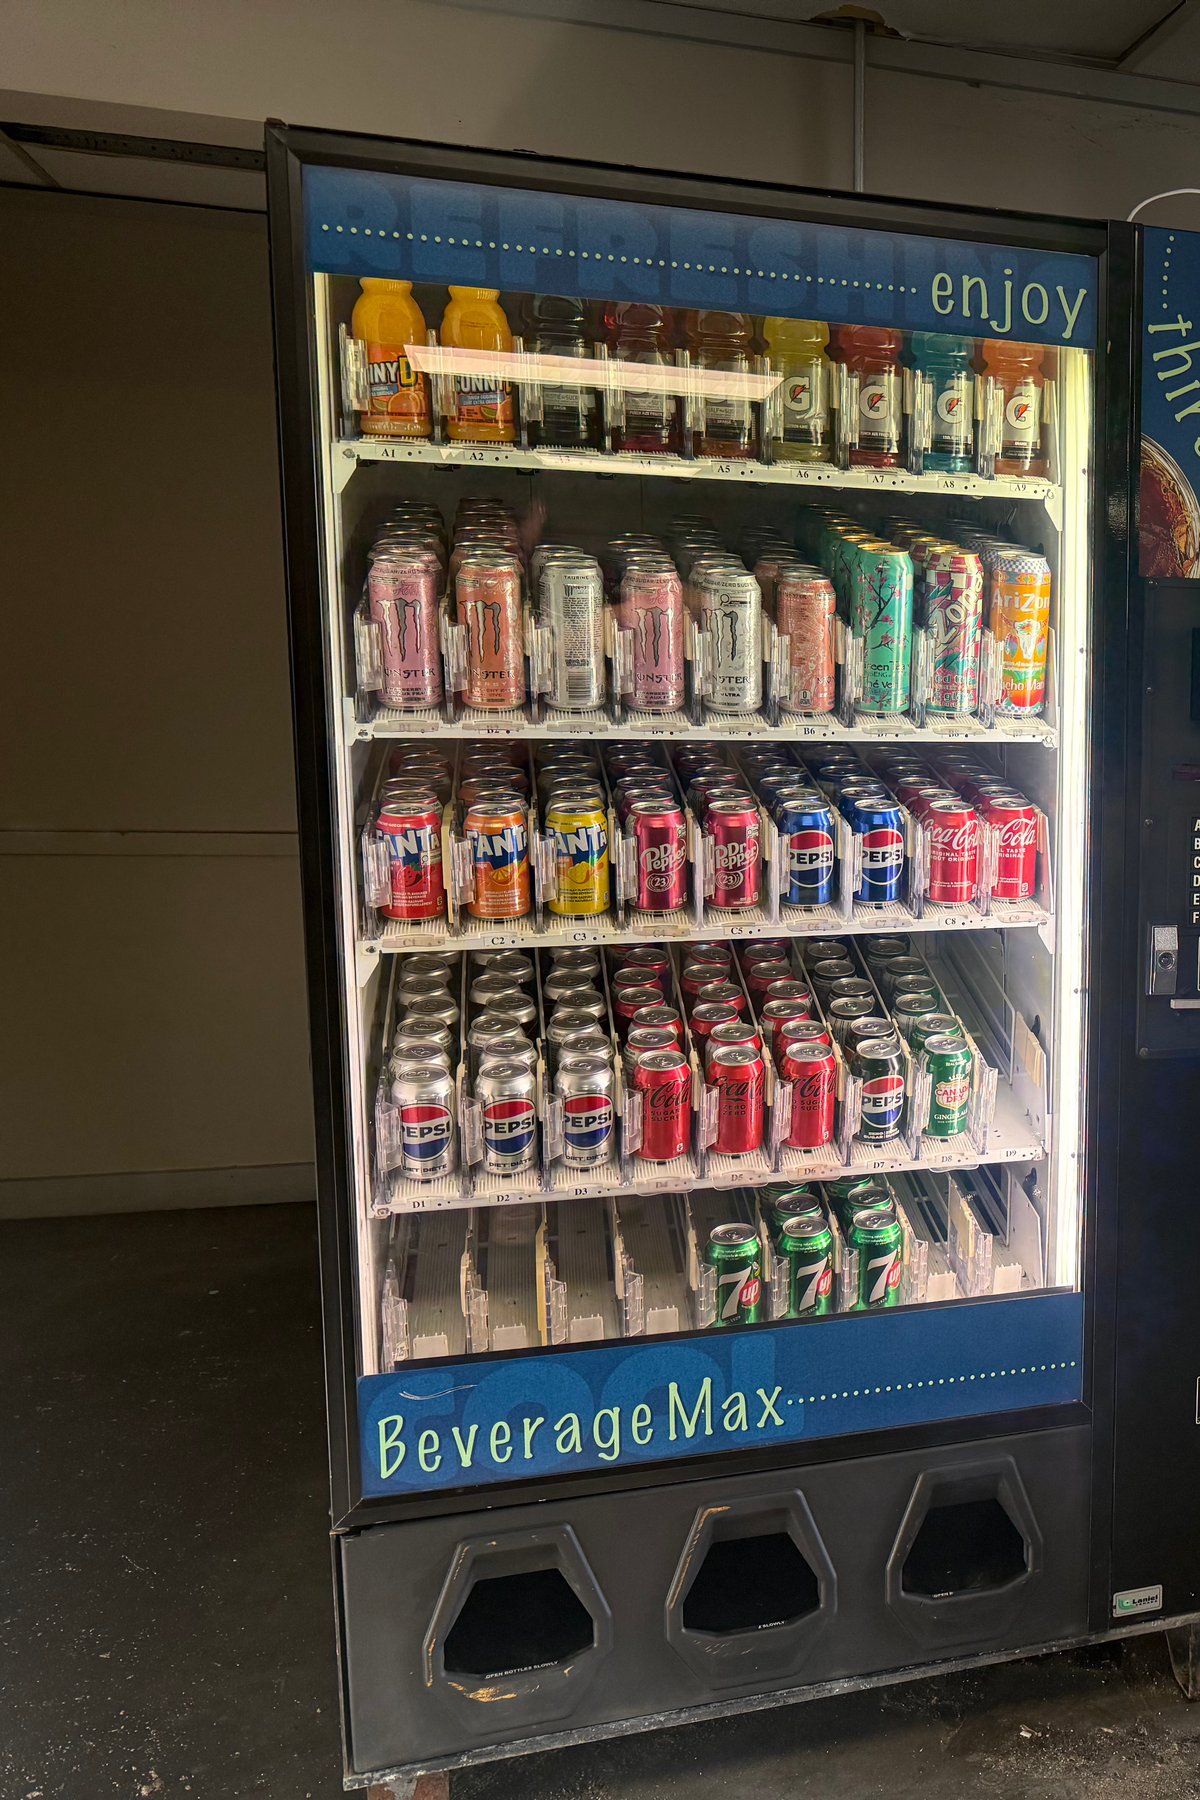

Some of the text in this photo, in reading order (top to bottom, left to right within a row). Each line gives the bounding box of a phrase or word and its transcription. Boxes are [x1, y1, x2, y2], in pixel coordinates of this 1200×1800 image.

[931, 269, 1088, 339] enjoy
[381, 448, 396, 458] A1
[469, 452, 484, 461] A2
[717, 465, 731, 473] A5
[796, 470, 809, 479] A6
[872, 475, 885, 483] A7
[942, 480, 955, 489] A8
[1014, 484, 1027, 492] A9
[991, 588, 1050, 613] AriZon
[467, 824, 529, 858] FANTA
[659, 842, 675, 856] Dr
[729, 842, 747, 855] Dr
[640, 840, 687, 872] Pepper
[715, 839, 759, 869] Pepper
[789, 851, 834, 865] PEPSI
[1193, 856, 1200, 868] C
[654, 877, 666, 887] 23
[723, 876, 735, 885] 23
[1193, 875, 1200, 887] D
[1193, 893, 1200, 905] E
[945, 917, 956, 925] C8
[1192, 911, 1200, 924] F
[731, 927, 743, 935] C5
[491, 936, 505, 945] C2
[573, 932, 587, 941] C3
[862, 1092, 903, 1108] PEPS
[946, 1094, 965, 1103] DRY
[485, 1113, 535, 1134] PEPSI
[564, 1109, 612, 1129] PEPSI
[1006, 1150, 1017, 1158] D9
[941, 1155, 953, 1163] D8
[402, 1165, 420, 1173] DIET
[873, 1161, 885, 1169] D7
[804, 1167, 816, 1175] D6
[731, 1173, 744, 1181] D5
[574, 1188, 588, 1196] D3
[496, 1194, 510, 1202] D2
[412, 1201, 426, 1209] D1
[867, 1249, 898, 1303] 7
[796, 1257, 828, 1312] 7
[718, 1265, 752, 1321] 7
